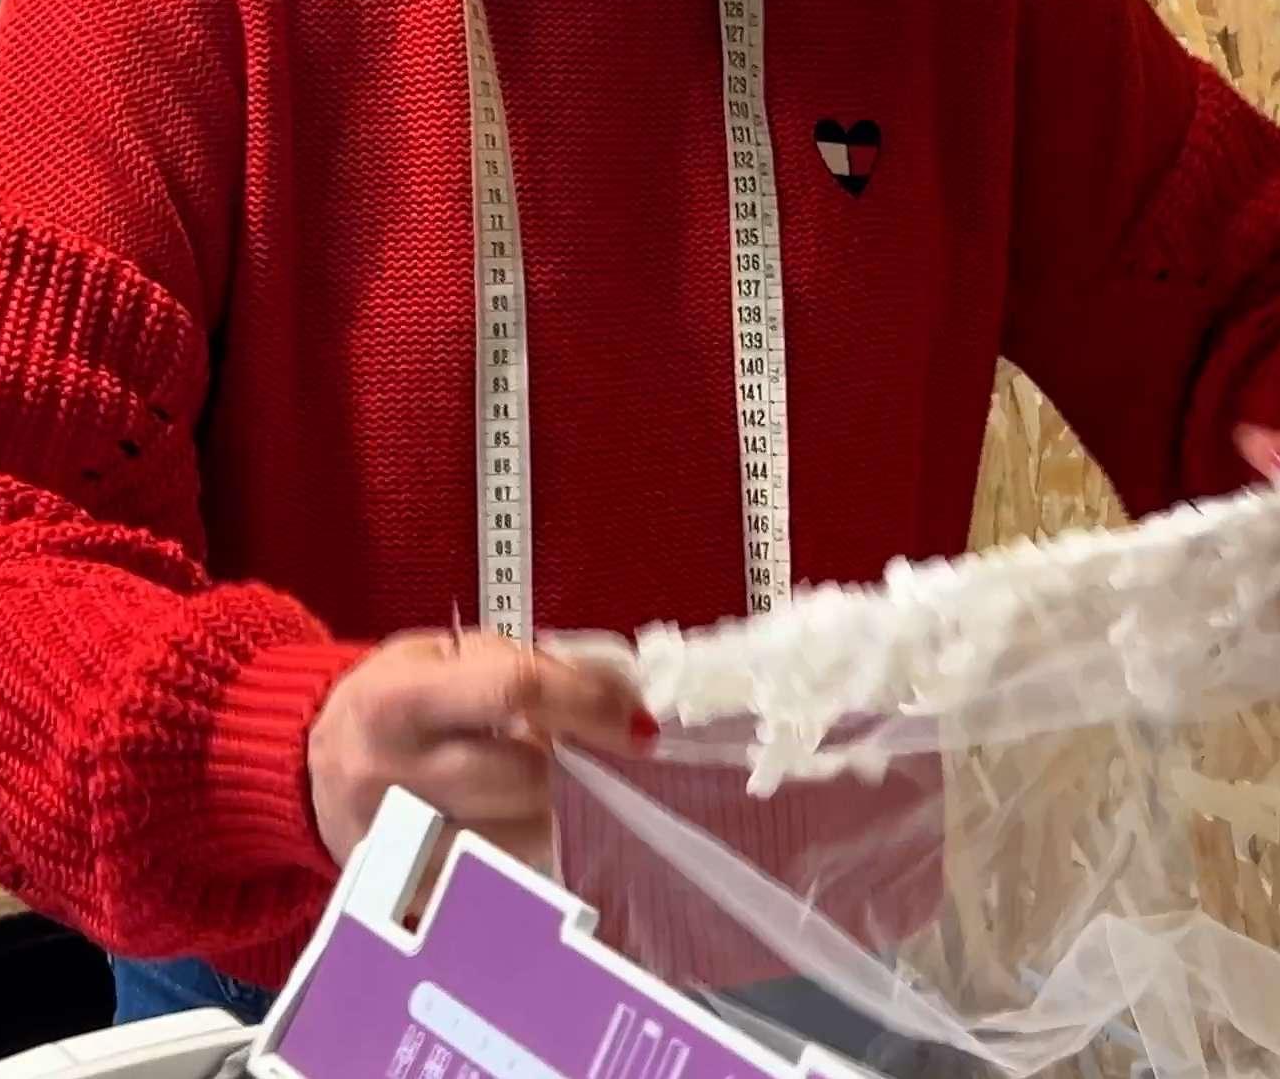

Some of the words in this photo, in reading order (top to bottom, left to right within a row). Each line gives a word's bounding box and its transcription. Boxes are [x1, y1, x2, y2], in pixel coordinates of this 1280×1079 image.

[724, 1, 744, 18] 126
[725, 25, 744, 42] 127
[727, 50, 746, 68] 128
[728, 74, 747, 94] 129
[729, 100, 749, 119] 130
[731, 125, 751, 144] 131
[733, 151, 754, 169] 132
[734, 176, 756, 194] 133
[735, 201, 757, 219] 134
[735, 228, 759, 246] 135
[736, 254, 760, 272] 136
[737, 279, 761, 297] 137
[737, 306, 761, 324] 138
[739, 331, 763, 350] 139
[740, 357, 764, 376] 140
[493, 377, 509, 392] 83
[739, 383, 763, 401] 141
[742, 409, 765, 427] 142
[494, 431, 510, 447] 85
[743, 435, 767, 454] 143
[745, 461, 768, 480] 144
[746, 488, 768, 506] 145
[747, 514, 769, 534] 146
[748, 541, 770, 560] 147
[496, 568, 513, 582] 90
[750, 567, 770, 586] 148
[497, 595, 511, 610] 91
[750, 594, 771, 612] 149
